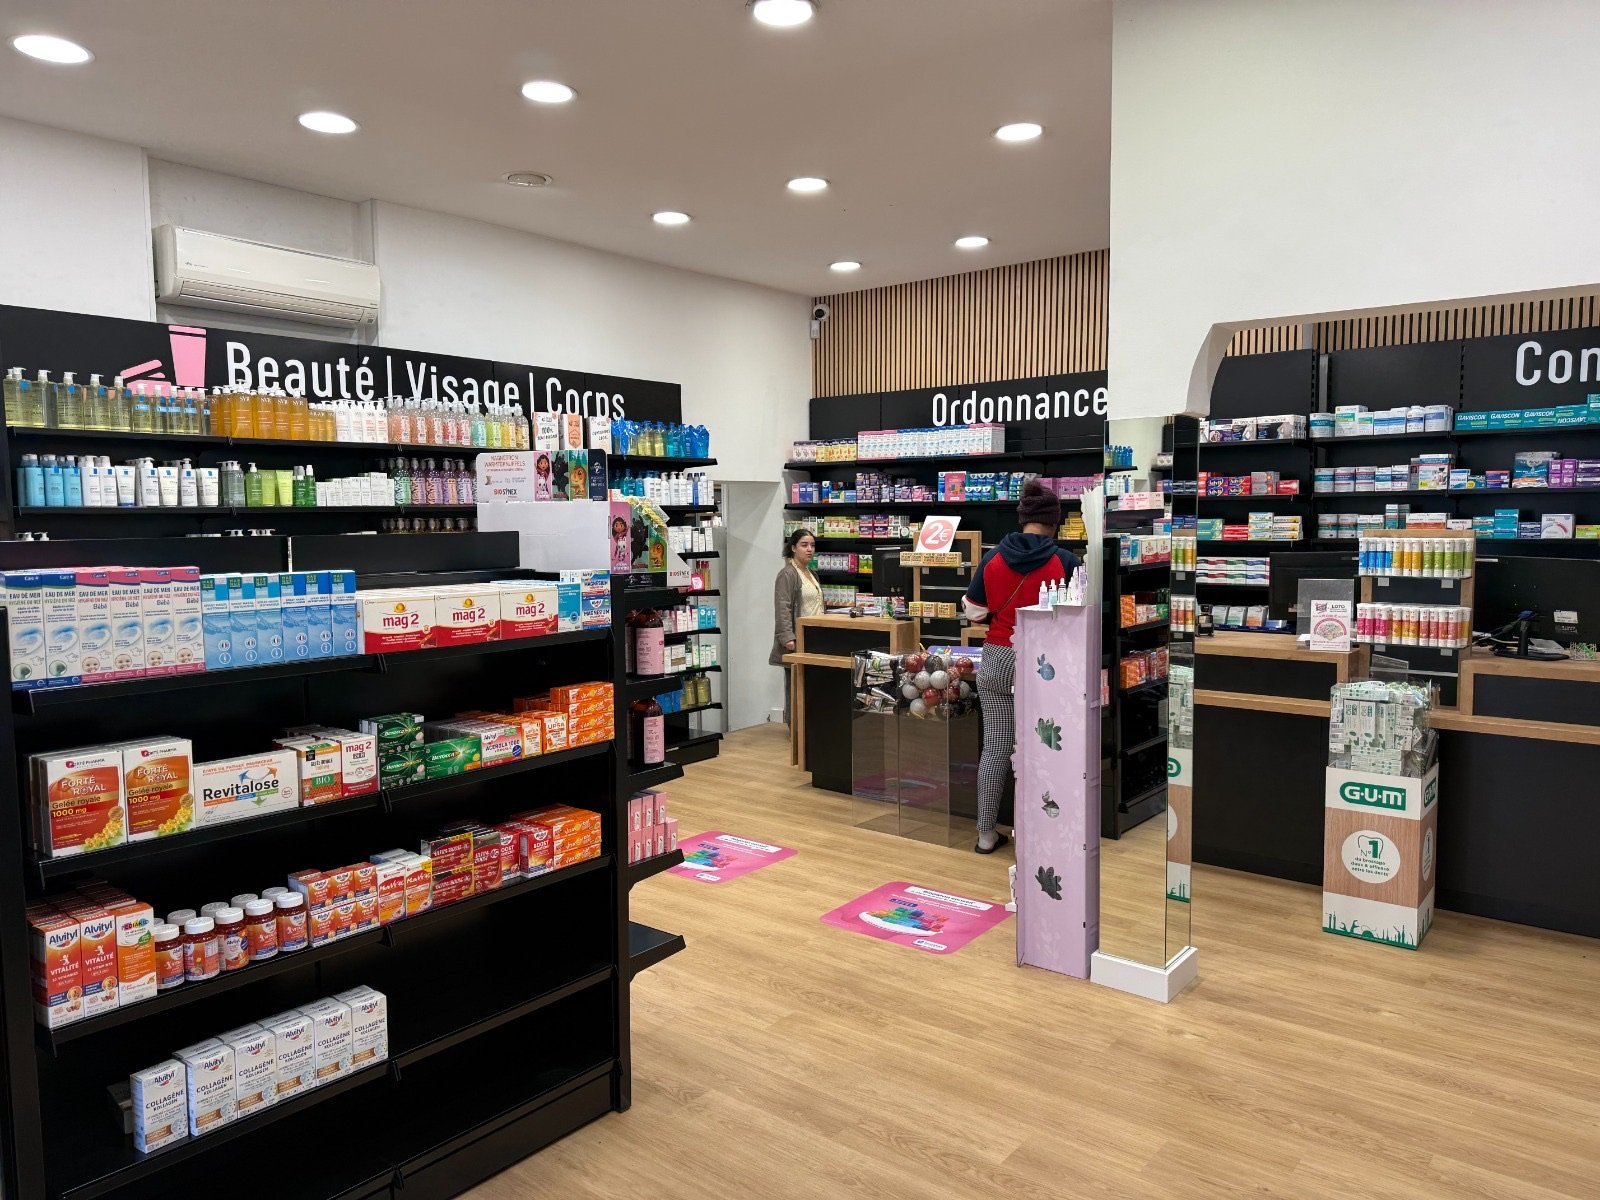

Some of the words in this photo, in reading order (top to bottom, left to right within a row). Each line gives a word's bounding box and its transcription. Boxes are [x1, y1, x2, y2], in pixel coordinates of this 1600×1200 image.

[1515, 340, 1600, 386] Con
[226, 341, 374, 402] Beauté
[405, 360, 520, 410] Visage
[546, 377, 625, 420] Corps
[932, 387, 1108, 426] Ordonnance
[1490, 412, 1520, 420] GAVISCON
[1524, 410, 1555, 418] GAVISCON
[453, 610, 475, 623] mag
[478, 608, 486, 619] 2
[516, 605, 537, 616] mag
[538, 603, 545, 613] 2
[383, 616, 409, 629] mag
[410, 613, 419, 625] 2
[384, 729, 405, 737] Berocca
[484, 732, 497, 740] Alvityl
[346, 744, 364, 752] mag
[366, 741, 372, 749] 2
[431, 752, 455, 761] Berocca
[137, 763, 169, 777] FORTÉ
[386, 762, 407, 770] Berocca
[62, 775, 96, 789] FORTÉ
[147, 772, 178, 783] ROYAL
[316, 776, 330, 785] BIO
[73, 783, 107, 796] ROYAL
[128, 787, 150, 797] Gelée
[151, 783, 174, 794] royale
[203, 779, 279, 801] Revitalose
[52, 798, 76, 810] Gelée
[77, 795, 101, 806] royale
[128, 795, 149, 805] 1000
[149, 794, 161, 803] mg
[52, 808, 74, 818] 1000
[75, 807, 87, 816] mg
[534, 841, 549, 849] BOOST
[84, 921, 113, 935] Alvityl
[49, 929, 78, 945] Alvityl
[85, 953, 114, 966] VITALITÉ
[50, 962, 79, 976] VITALITÉ
[361, 1001, 378, 1012] Alvityl
[325, 1013, 343, 1025] Alvityl
[354, 1018, 385, 1033] COLLAGÈNE
[285, 1027, 305, 1038] Alvityl
[318, 1031, 351, 1047] COLLAGÈNE
[247, 1041, 265, 1053] Alvityl
[278, 1044, 312, 1060] COLLAGÈNE
[204, 1056, 224, 1070] Alvityl
[238, 1059, 274, 1077] COLLAGÈNE
[154, 1071, 175, 1084] Alvityl
[196, 1075, 234, 1093] COLLAGÈNE
[145, 1089, 185, 1109] COLLAGÈNE
[153, 1099, 178, 1112] KOLLAGEN
